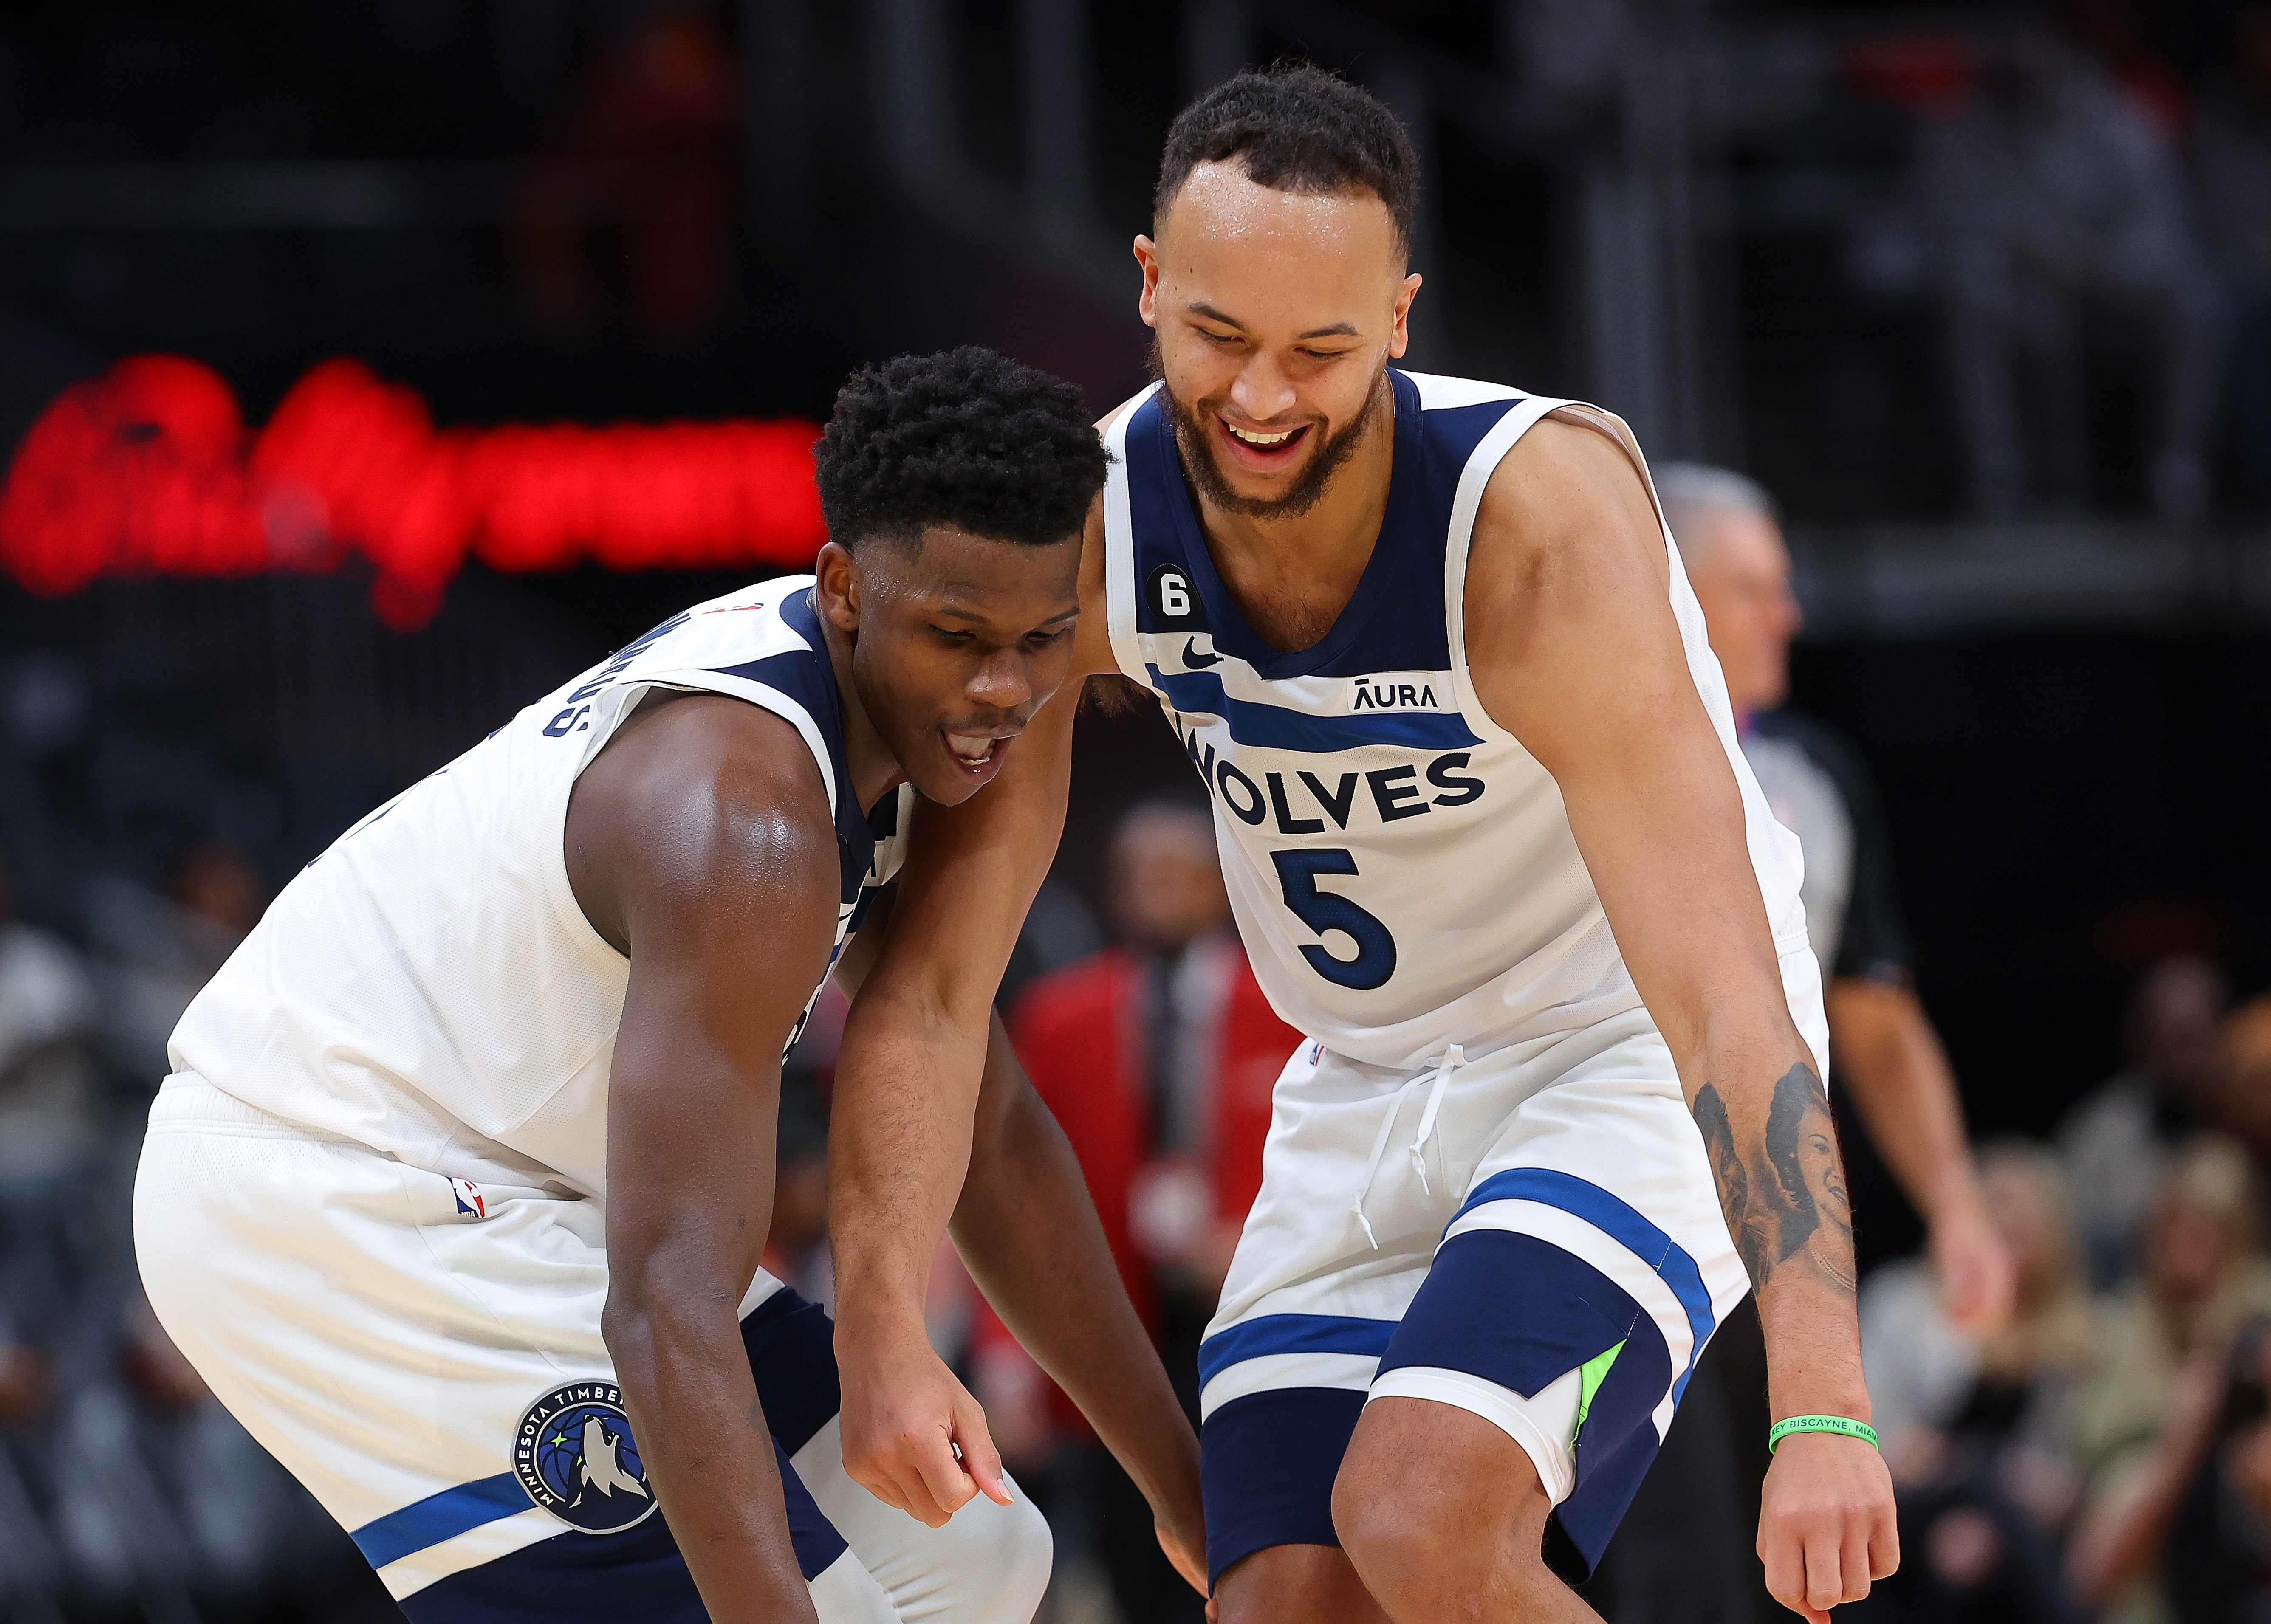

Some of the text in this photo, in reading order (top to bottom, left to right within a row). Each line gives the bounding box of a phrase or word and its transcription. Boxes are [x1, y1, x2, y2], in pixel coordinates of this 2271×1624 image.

[1161, 573, 1191, 616] 6
[1174, 711, 1486, 835] WOLVES
[1269, 848, 1397, 991] 5
[518, 1407, 554, 1506] MINNESOTA
[1771, 1423, 1786, 1436] KEY
[1789, 1418, 1851, 1432] BISCAYNE,
